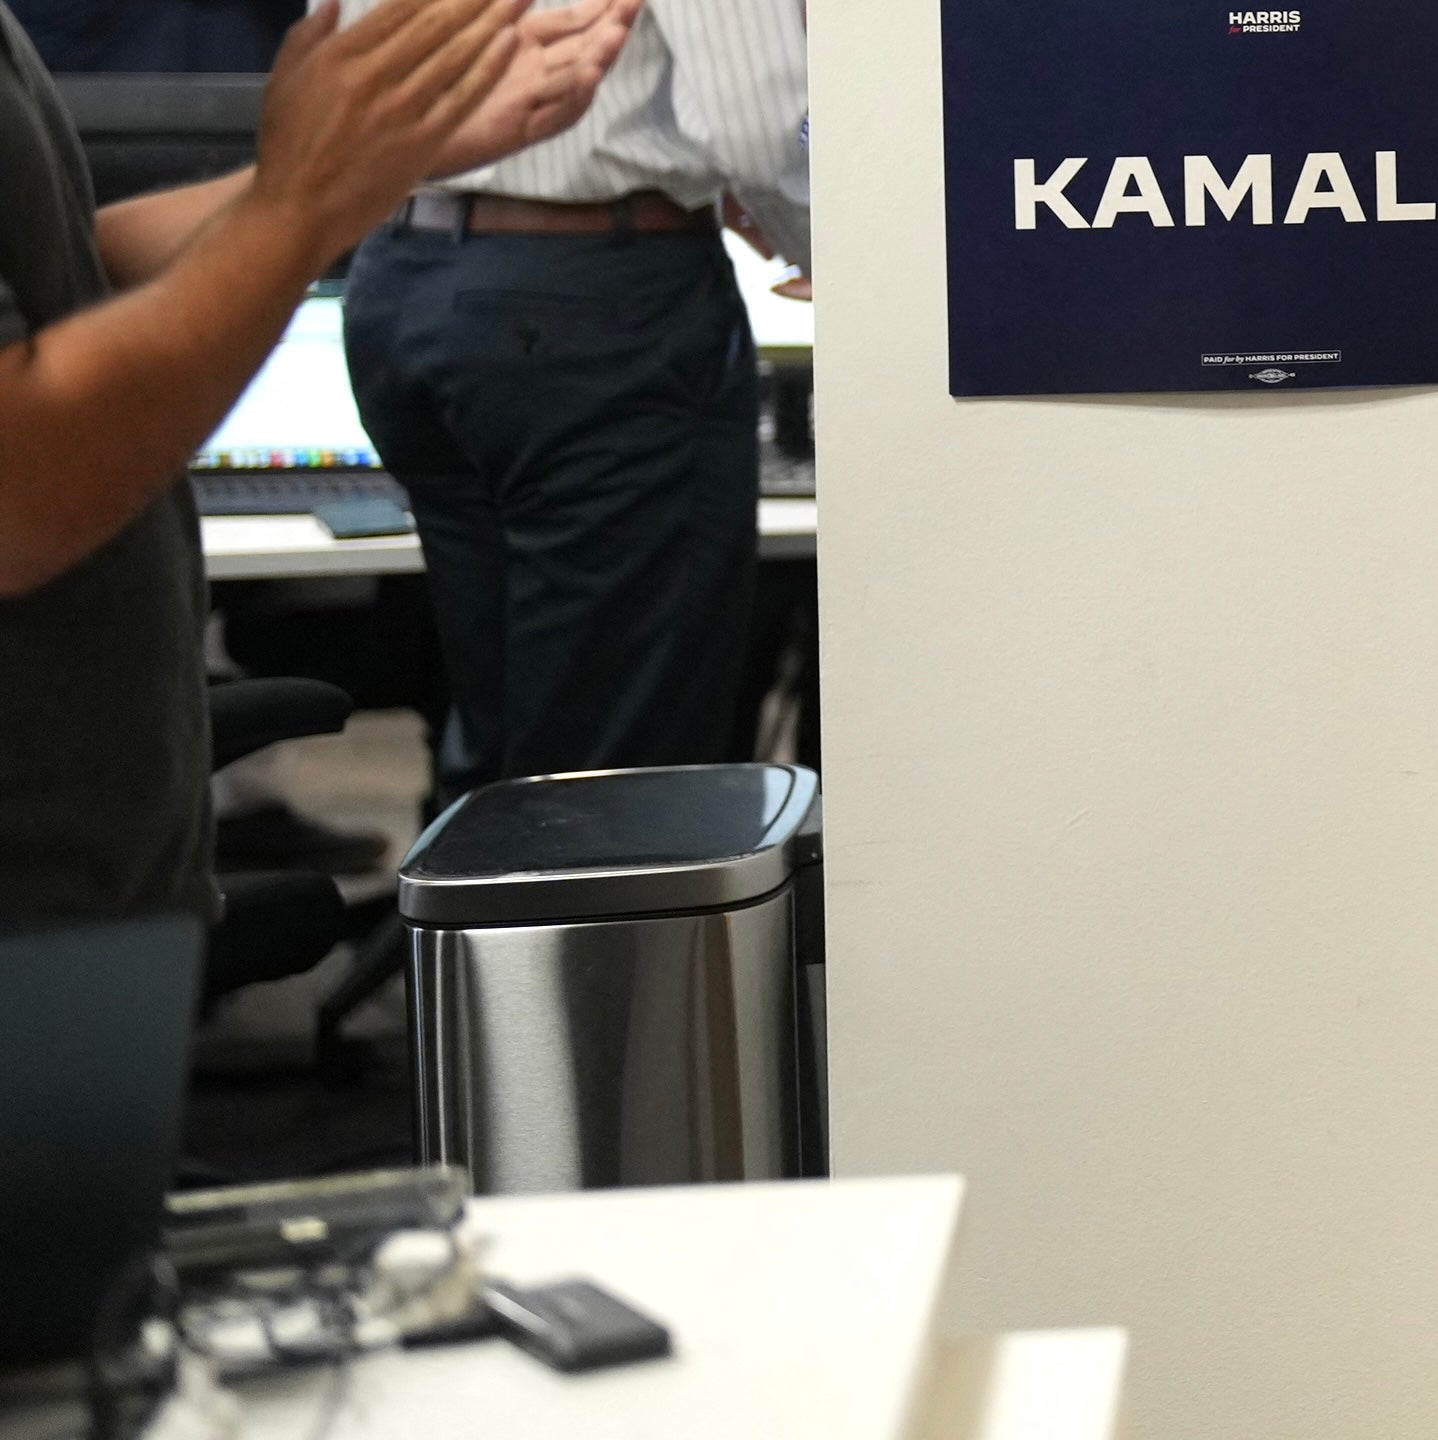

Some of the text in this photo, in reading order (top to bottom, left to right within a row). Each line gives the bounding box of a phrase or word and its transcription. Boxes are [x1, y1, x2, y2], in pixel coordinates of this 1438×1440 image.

[1228, 10, 1301, 25] HARRIS
[1242, 24, 1301, 33] PRESIDENT
[1223, 356, 1235, 364] for
[1235, 356, 1245, 364] by
[1245, 354, 1276, 362] HARRIS
[1293, 352, 1339, 360] PRESIDENT
